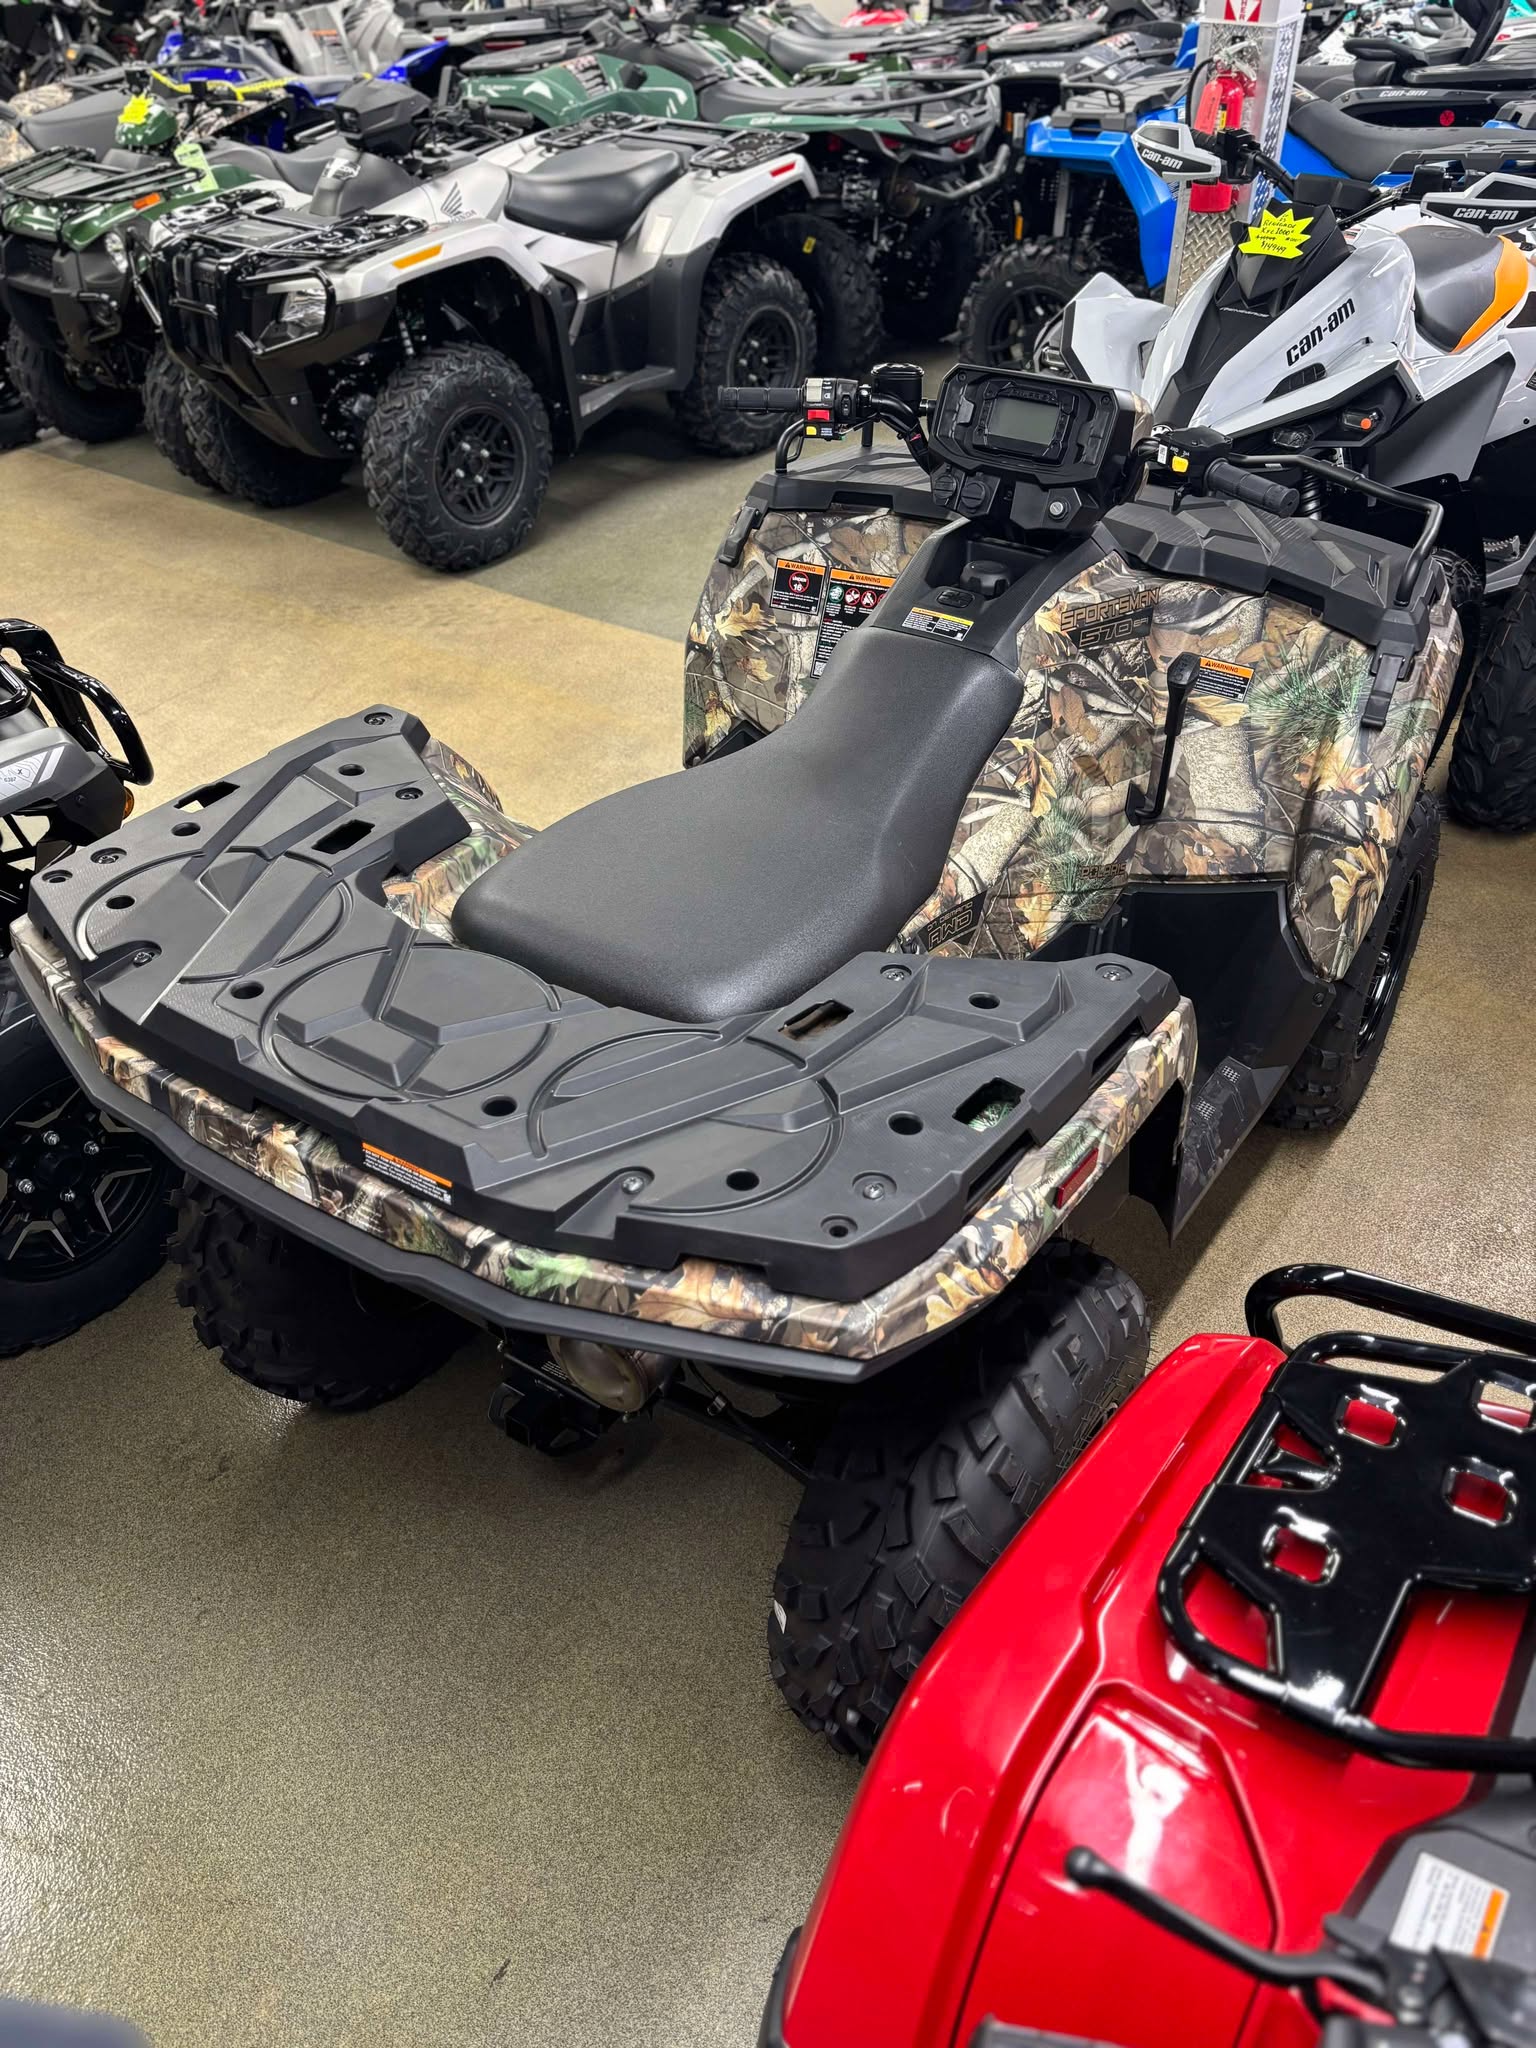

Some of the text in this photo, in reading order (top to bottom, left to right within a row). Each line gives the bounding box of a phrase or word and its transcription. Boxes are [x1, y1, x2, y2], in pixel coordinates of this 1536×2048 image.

[1379, 89, 1428, 98] can-am
[1141, 148, 1183, 170] can-am
[1453, 207, 1519, 221] can-am
[1286, 297, 1356, 367] can-am
[790, 562, 816, 572] WARNING
[855, 574, 881, 584] WARNING
[793, 583, 804, 592] 16
[1060, 586, 1161, 632] SPORTSMAN
[1080, 618, 1134, 648] 570
[1211, 661, 1239, 673] WARNING
[1081, 863, 1127, 880] POLARIS
[928, 909, 973, 951] AWD
